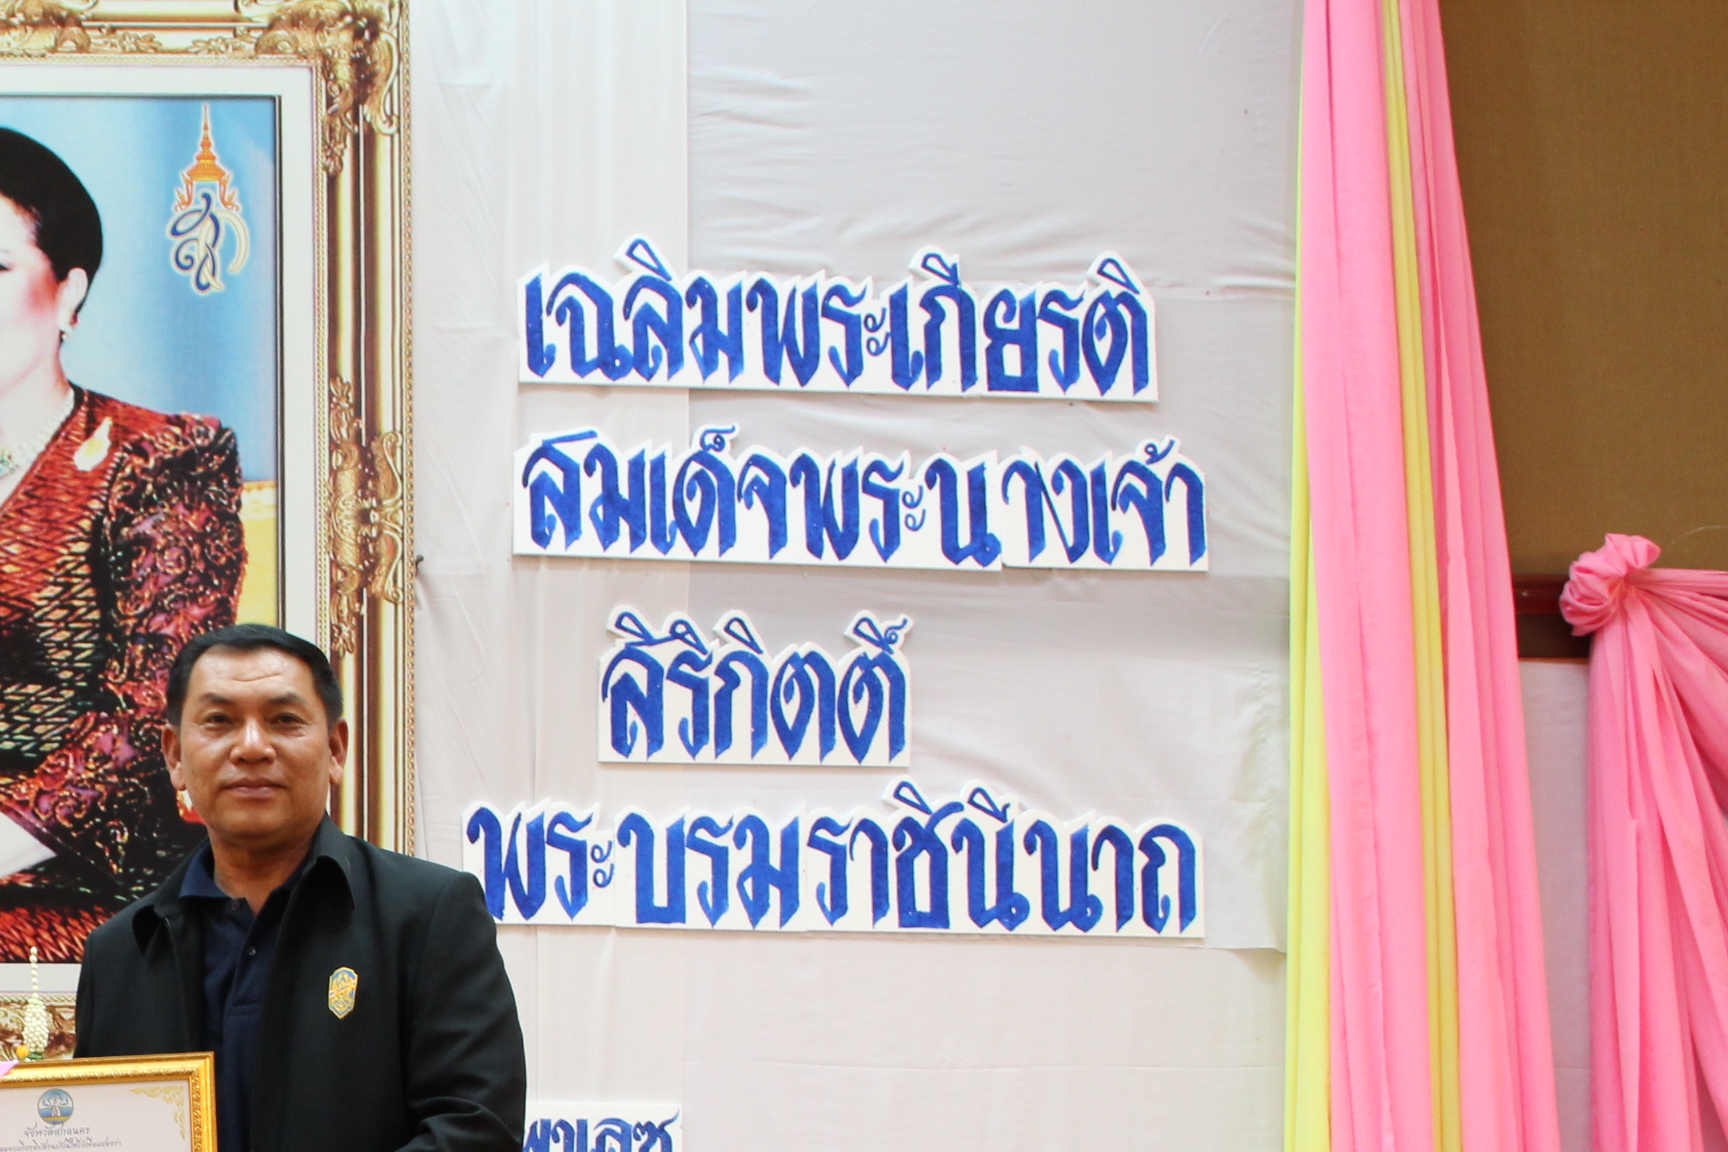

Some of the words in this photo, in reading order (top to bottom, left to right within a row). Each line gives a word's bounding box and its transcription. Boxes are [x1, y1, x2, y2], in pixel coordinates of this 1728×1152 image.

[526, 237, 1150, 395] เฉลิมพระเกียรติ
[522, 424, 1208, 567] สมเด็จพระนางเจ้า
[601, 611, 909, 763] สิริกิตติ์
[466, 780, 1198, 933] พระบรมราชินีนาถ
